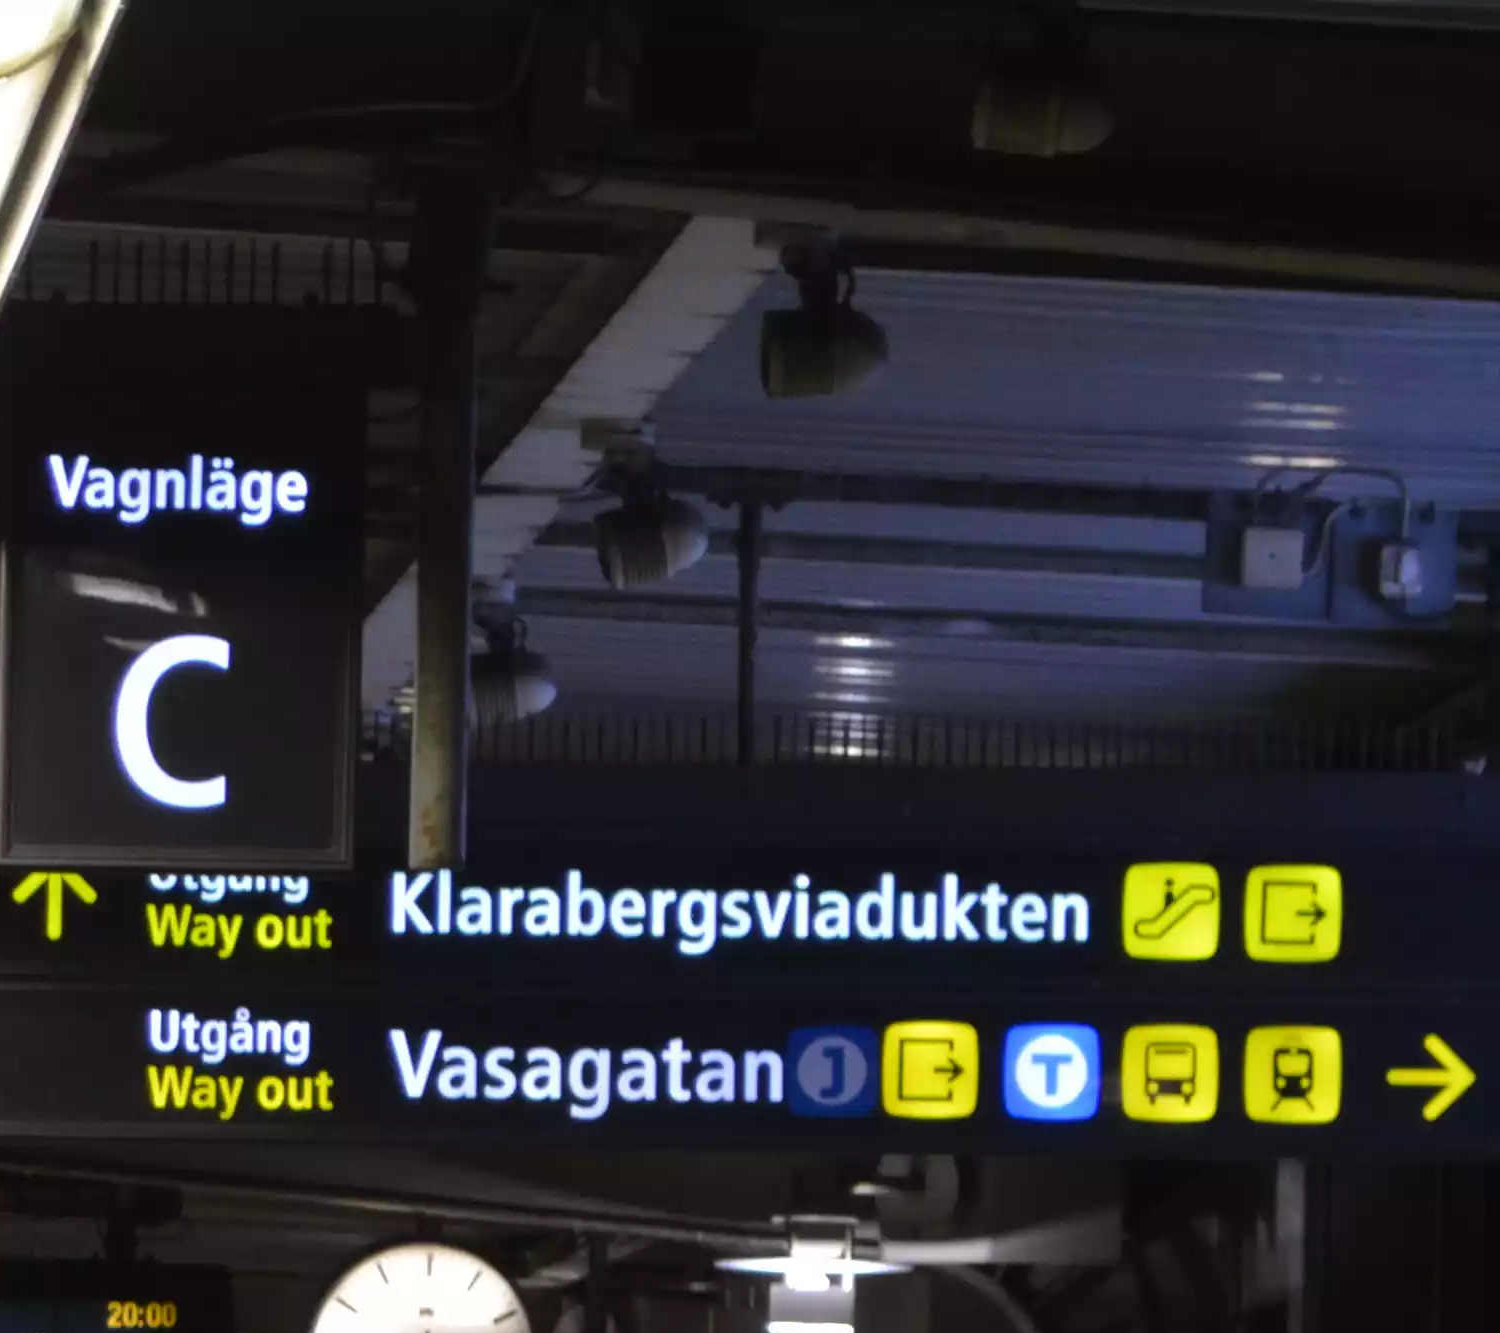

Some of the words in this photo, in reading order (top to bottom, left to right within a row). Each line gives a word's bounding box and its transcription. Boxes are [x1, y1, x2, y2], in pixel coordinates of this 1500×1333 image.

[48, 453, 308, 525] Vagnläge
[115, 633, 230, 809] C
[146, 903, 242, 959] Way
[256, 909, 333, 949] out
[388, 869, 1090, 955] Klarabergsviadukten
[147, 1006, 310, 1064] Utgång
[146, 1065, 243, 1120] Way
[257, 1070, 334, 1111] out
[388, 1028, 784, 1120] Vasagatan
[106, 1301, 176, 1329] 20:00
